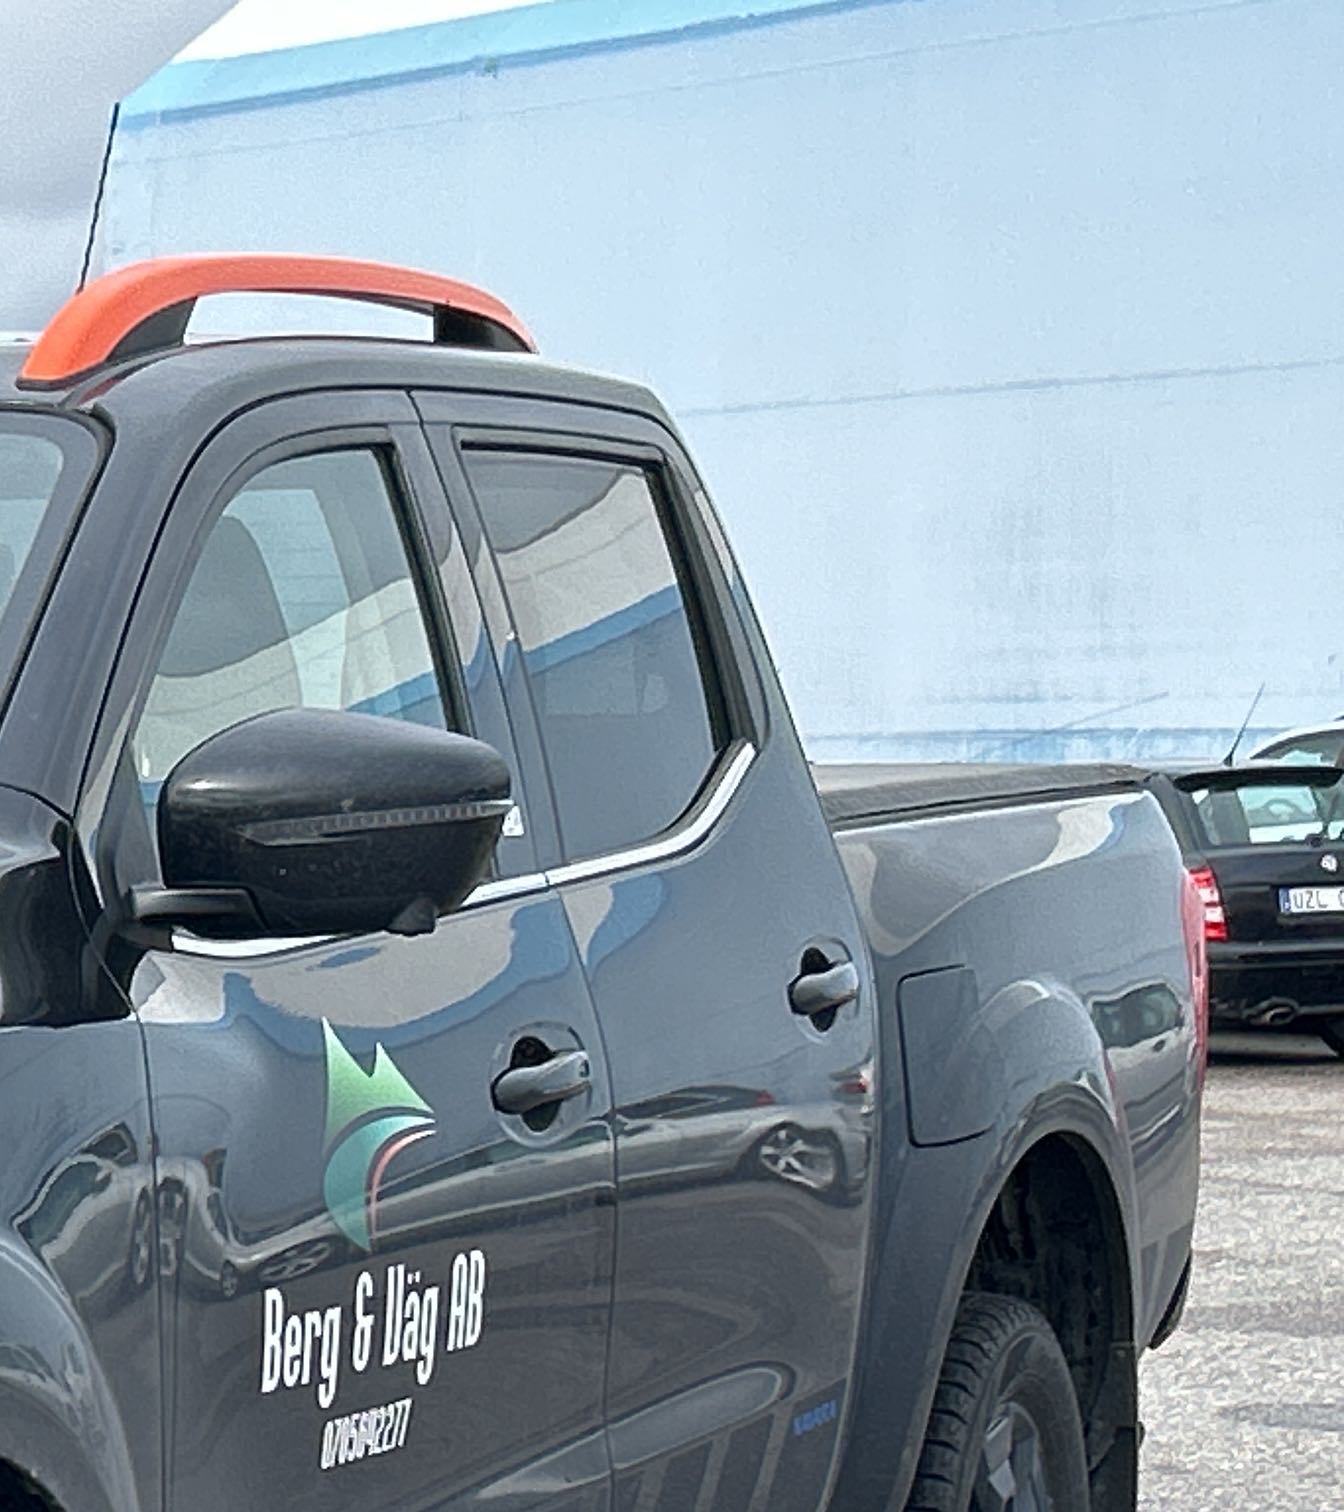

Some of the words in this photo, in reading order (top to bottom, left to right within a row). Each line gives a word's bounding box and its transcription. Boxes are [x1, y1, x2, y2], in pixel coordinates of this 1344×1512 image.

[262, 1288, 342, 1408] Berg
[353, 1271, 375, 1372] &
[447, 1250, 485, 1351] AB
